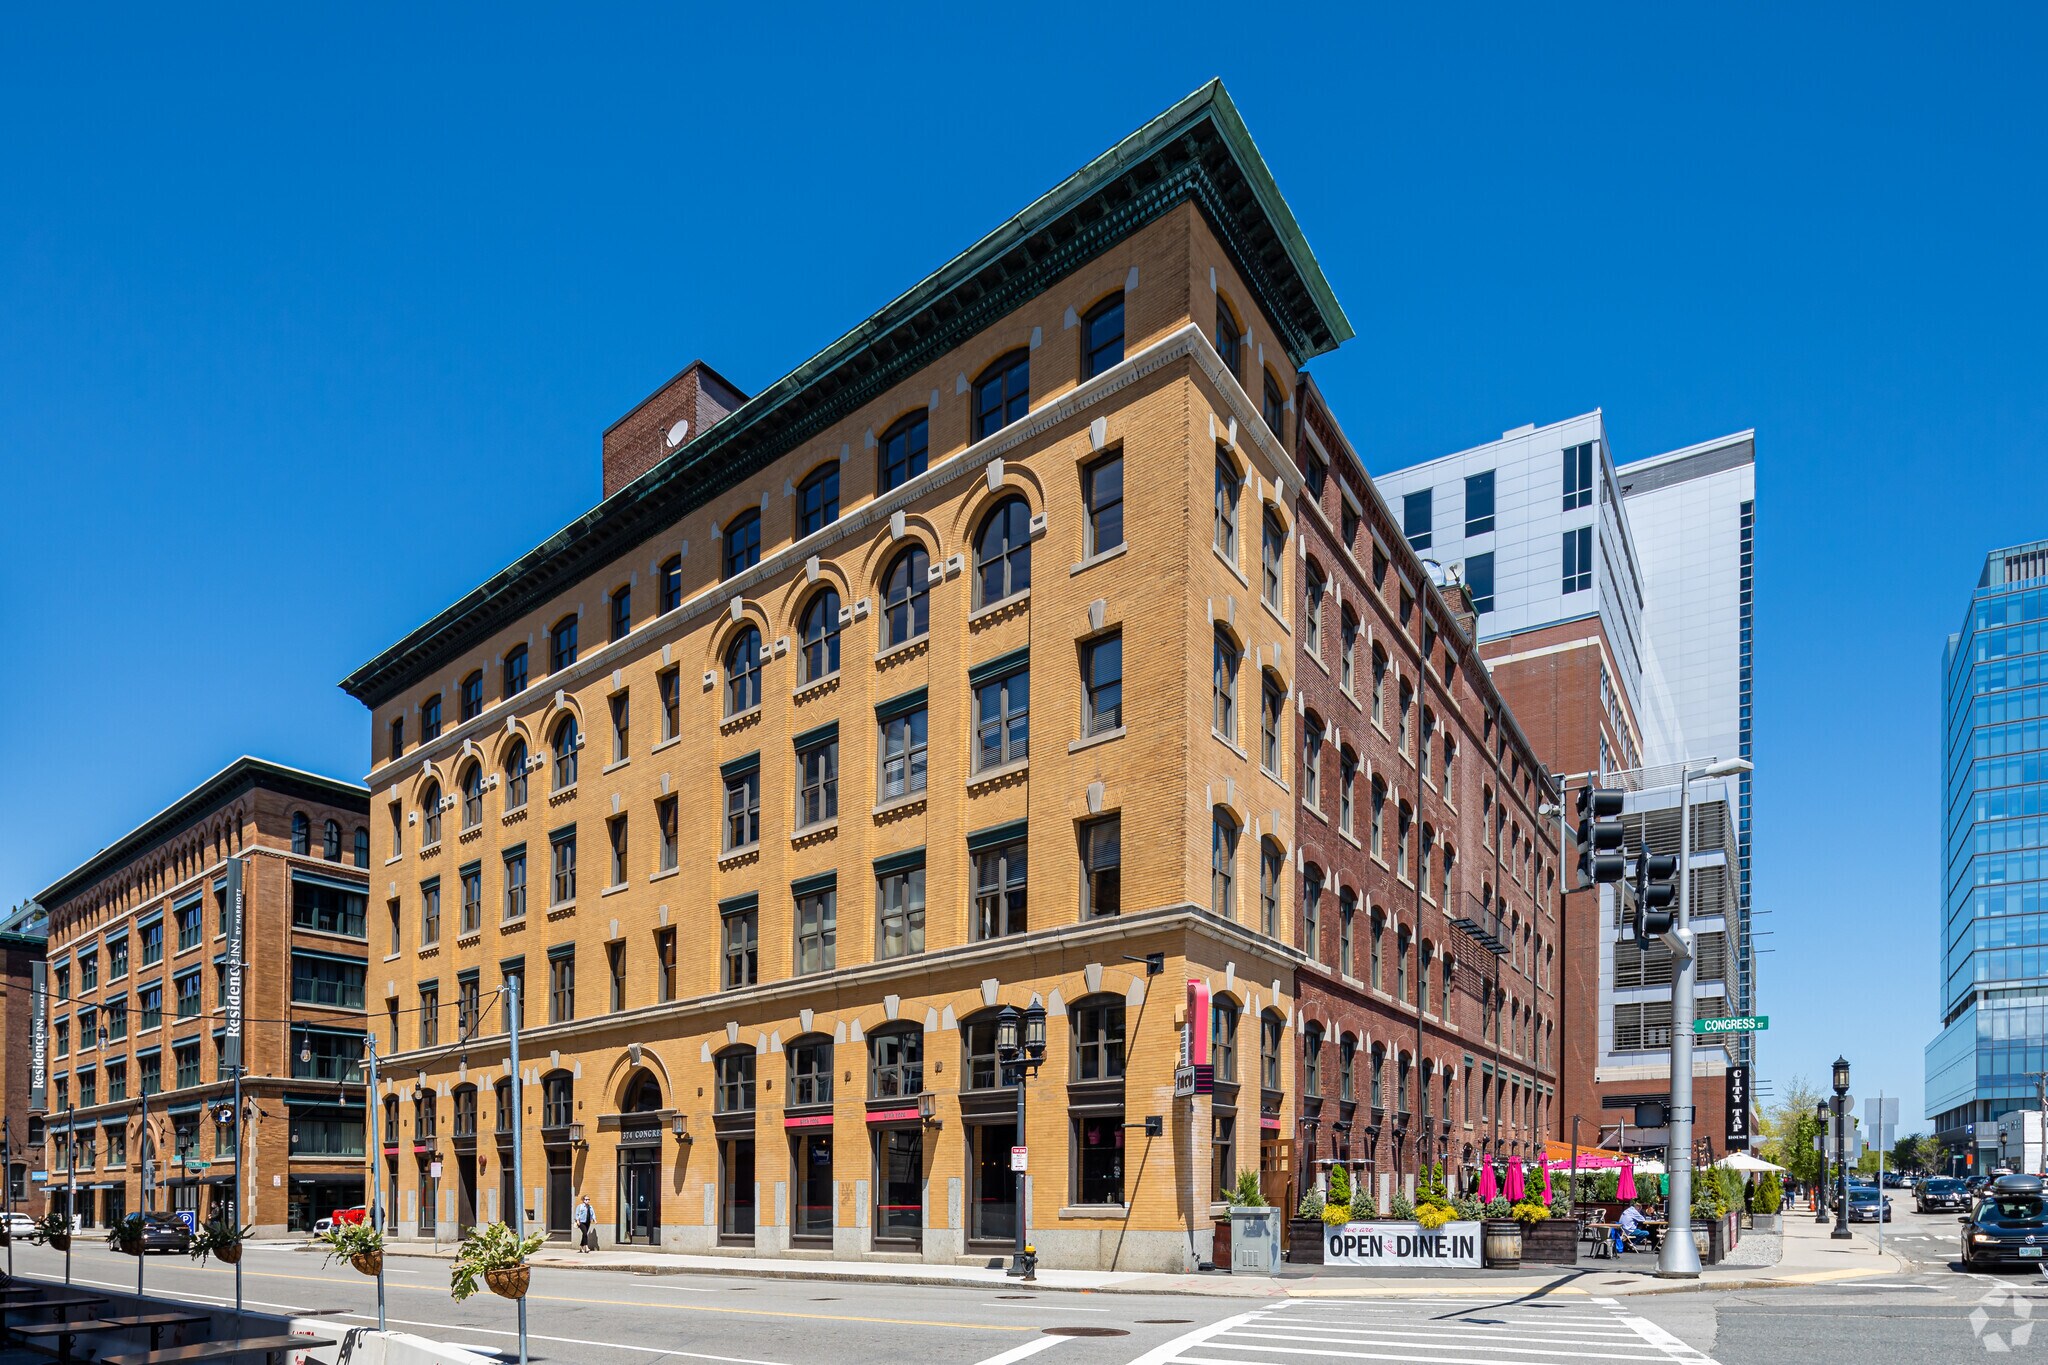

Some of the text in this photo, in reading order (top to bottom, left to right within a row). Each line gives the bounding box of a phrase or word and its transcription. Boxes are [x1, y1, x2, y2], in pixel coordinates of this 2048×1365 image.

[235, 925, 241, 935] BY
[226, 938, 241, 1037] Residence INN
[1704, 1018, 1755, 1031] CONGRESS
[32, 1018, 45, 1088] Residence INN
[1732, 1069, 1743, 1103] CITY
[1732, 1108, 1743, 1132] TAP
[182, 1215, 189, 1223] P
[1329, 1235, 1383, 1258] OPEN
[1396, 1235, 1474, 1258] DINE-IN
